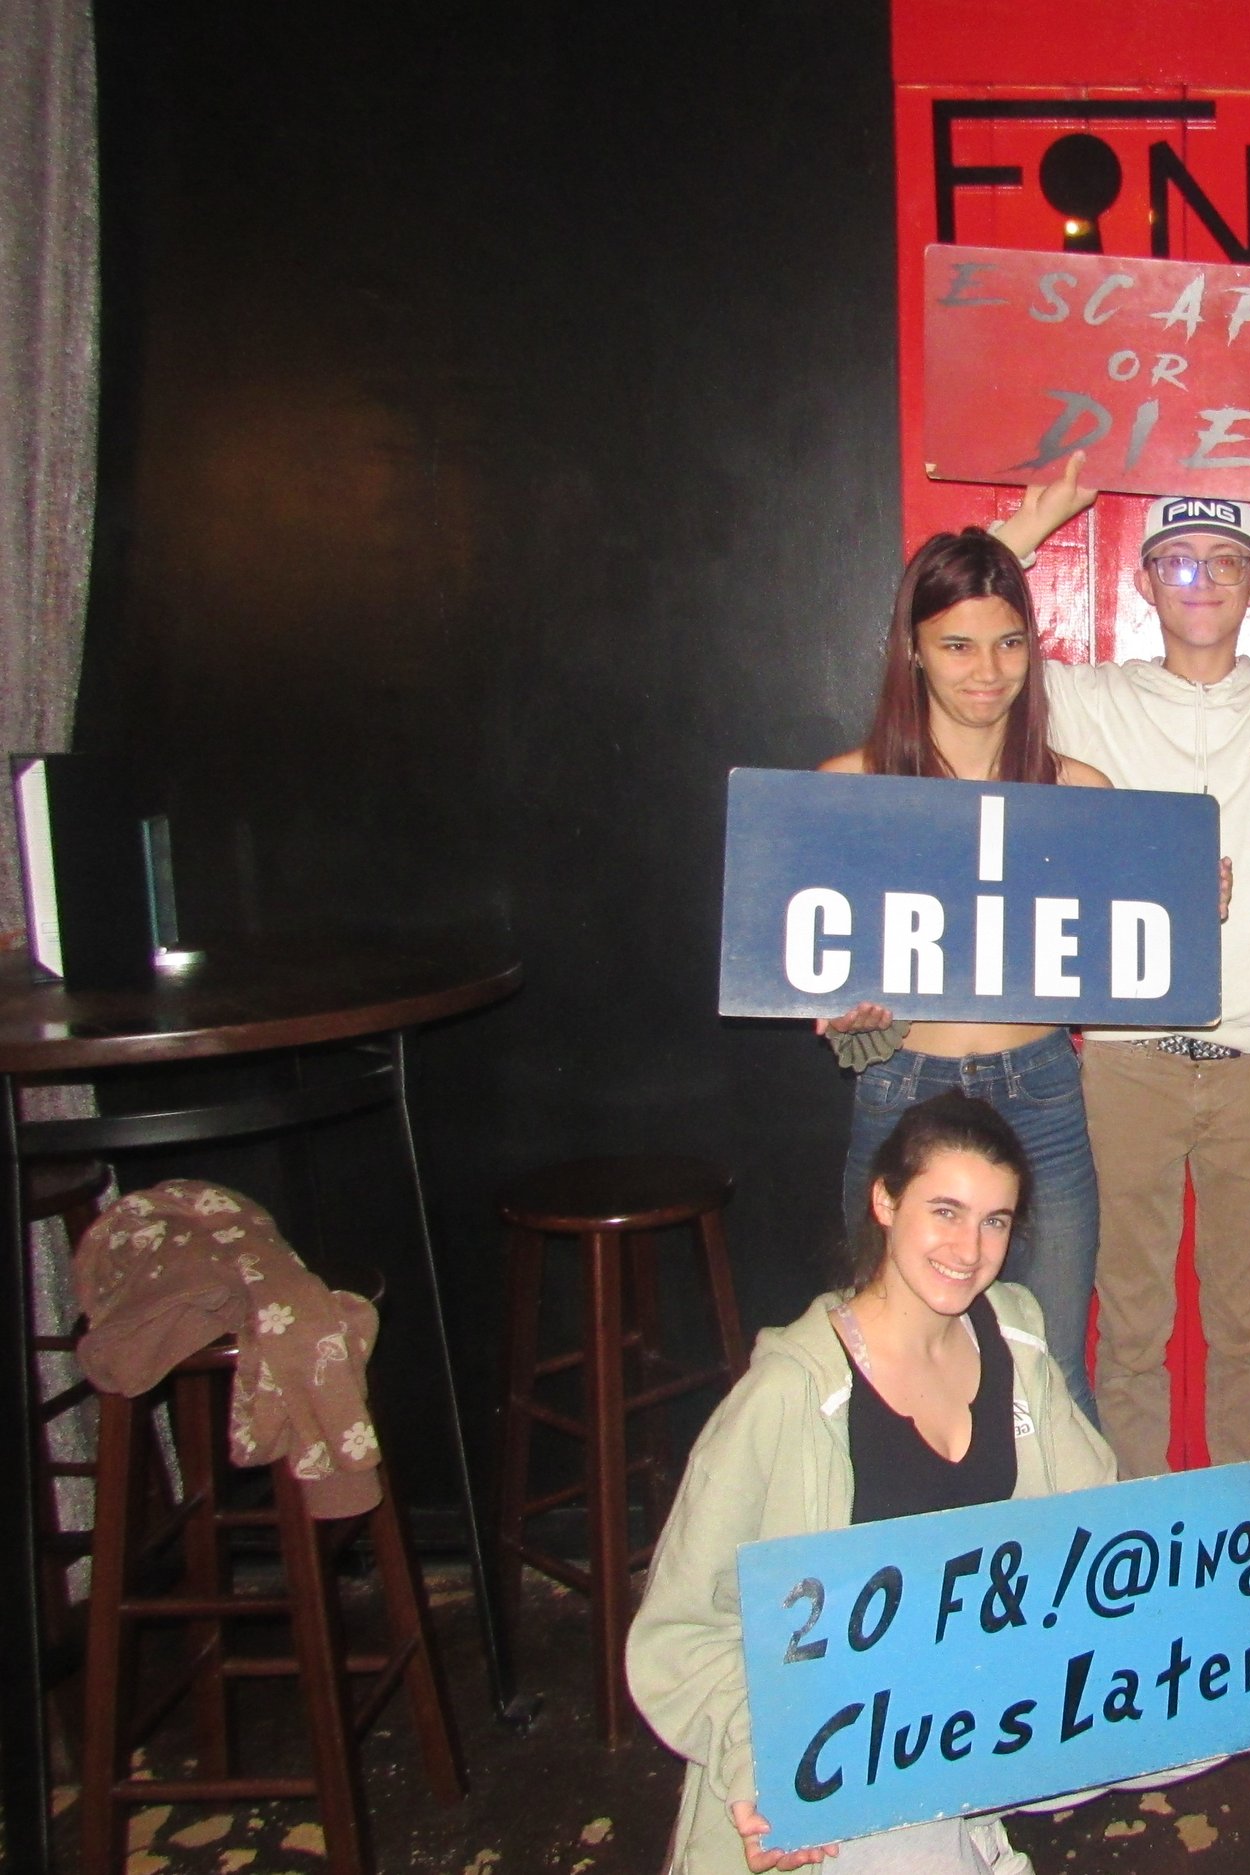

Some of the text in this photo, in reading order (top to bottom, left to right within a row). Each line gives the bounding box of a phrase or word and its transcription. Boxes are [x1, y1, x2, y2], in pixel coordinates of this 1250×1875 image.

[1108, 350, 1190, 392] OR
[1167, 500, 1236, 523] PING
[979, 796, 1004, 881] I
